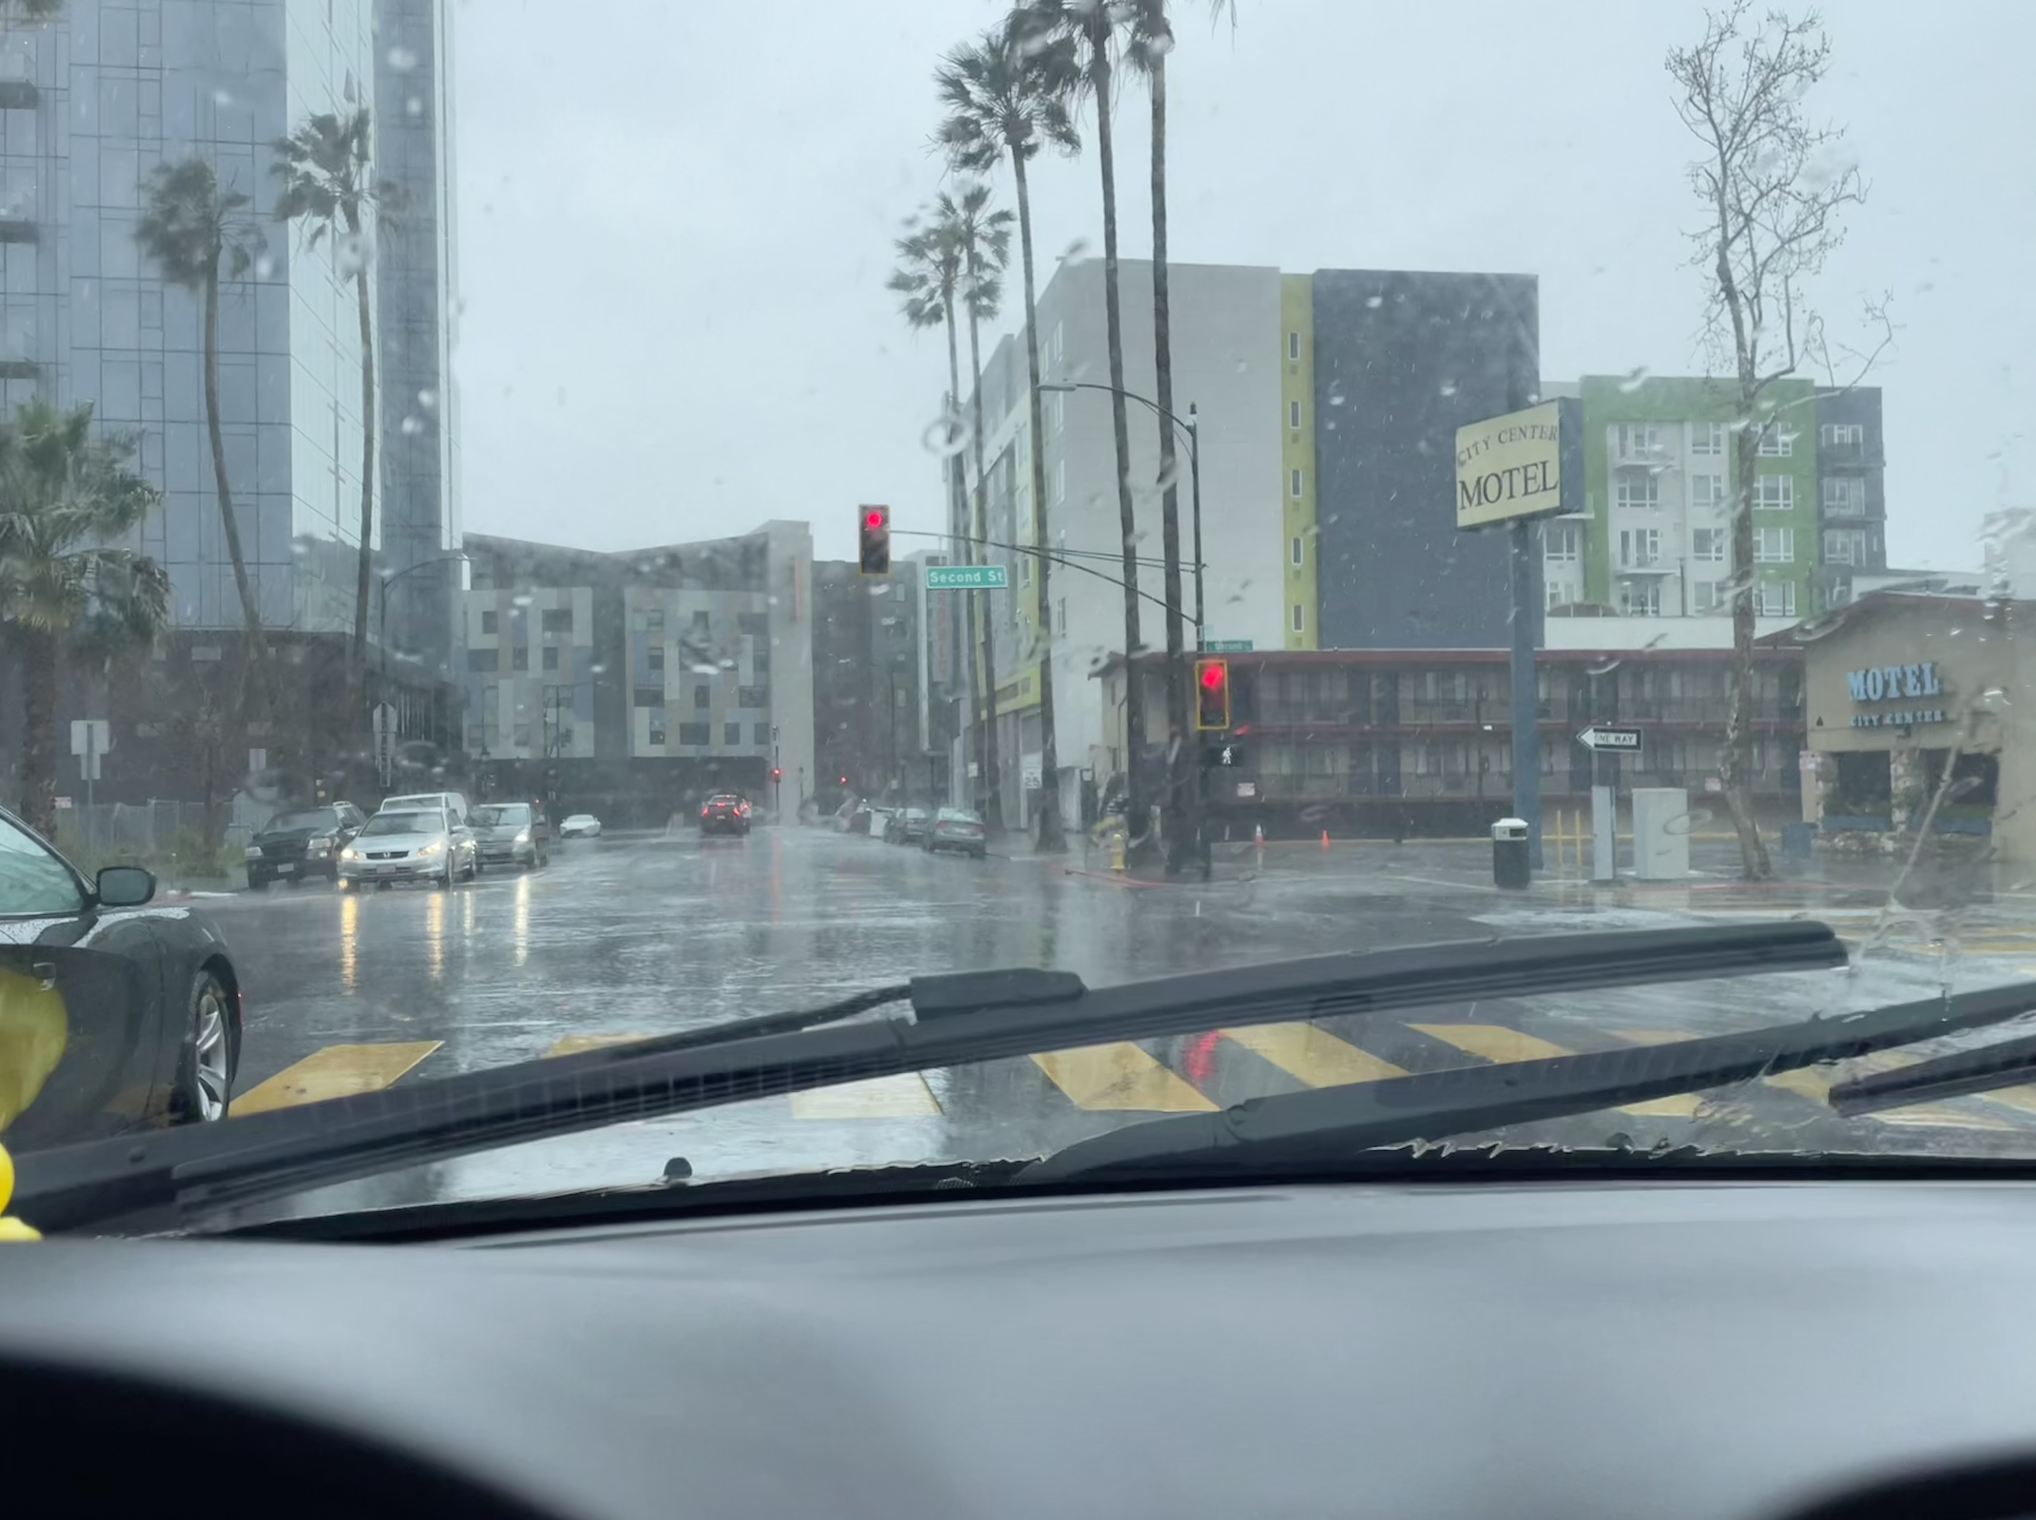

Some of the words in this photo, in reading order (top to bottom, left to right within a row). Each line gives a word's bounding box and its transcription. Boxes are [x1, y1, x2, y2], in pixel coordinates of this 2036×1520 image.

[1457, 435, 1490, 468] CITY
[1498, 425, 1558, 444] CENTER
[1459, 460, 1559, 510] MOTEL
[929, 571, 981, 583] Second
[988, 570, 1004, 582] St
[1846, 662, 1940, 700] MOTEL
[1850, 714, 1879, 727] CITY
[1594, 734, 1609, 743] ONE
[1614, 735, 1634, 743] WAY
